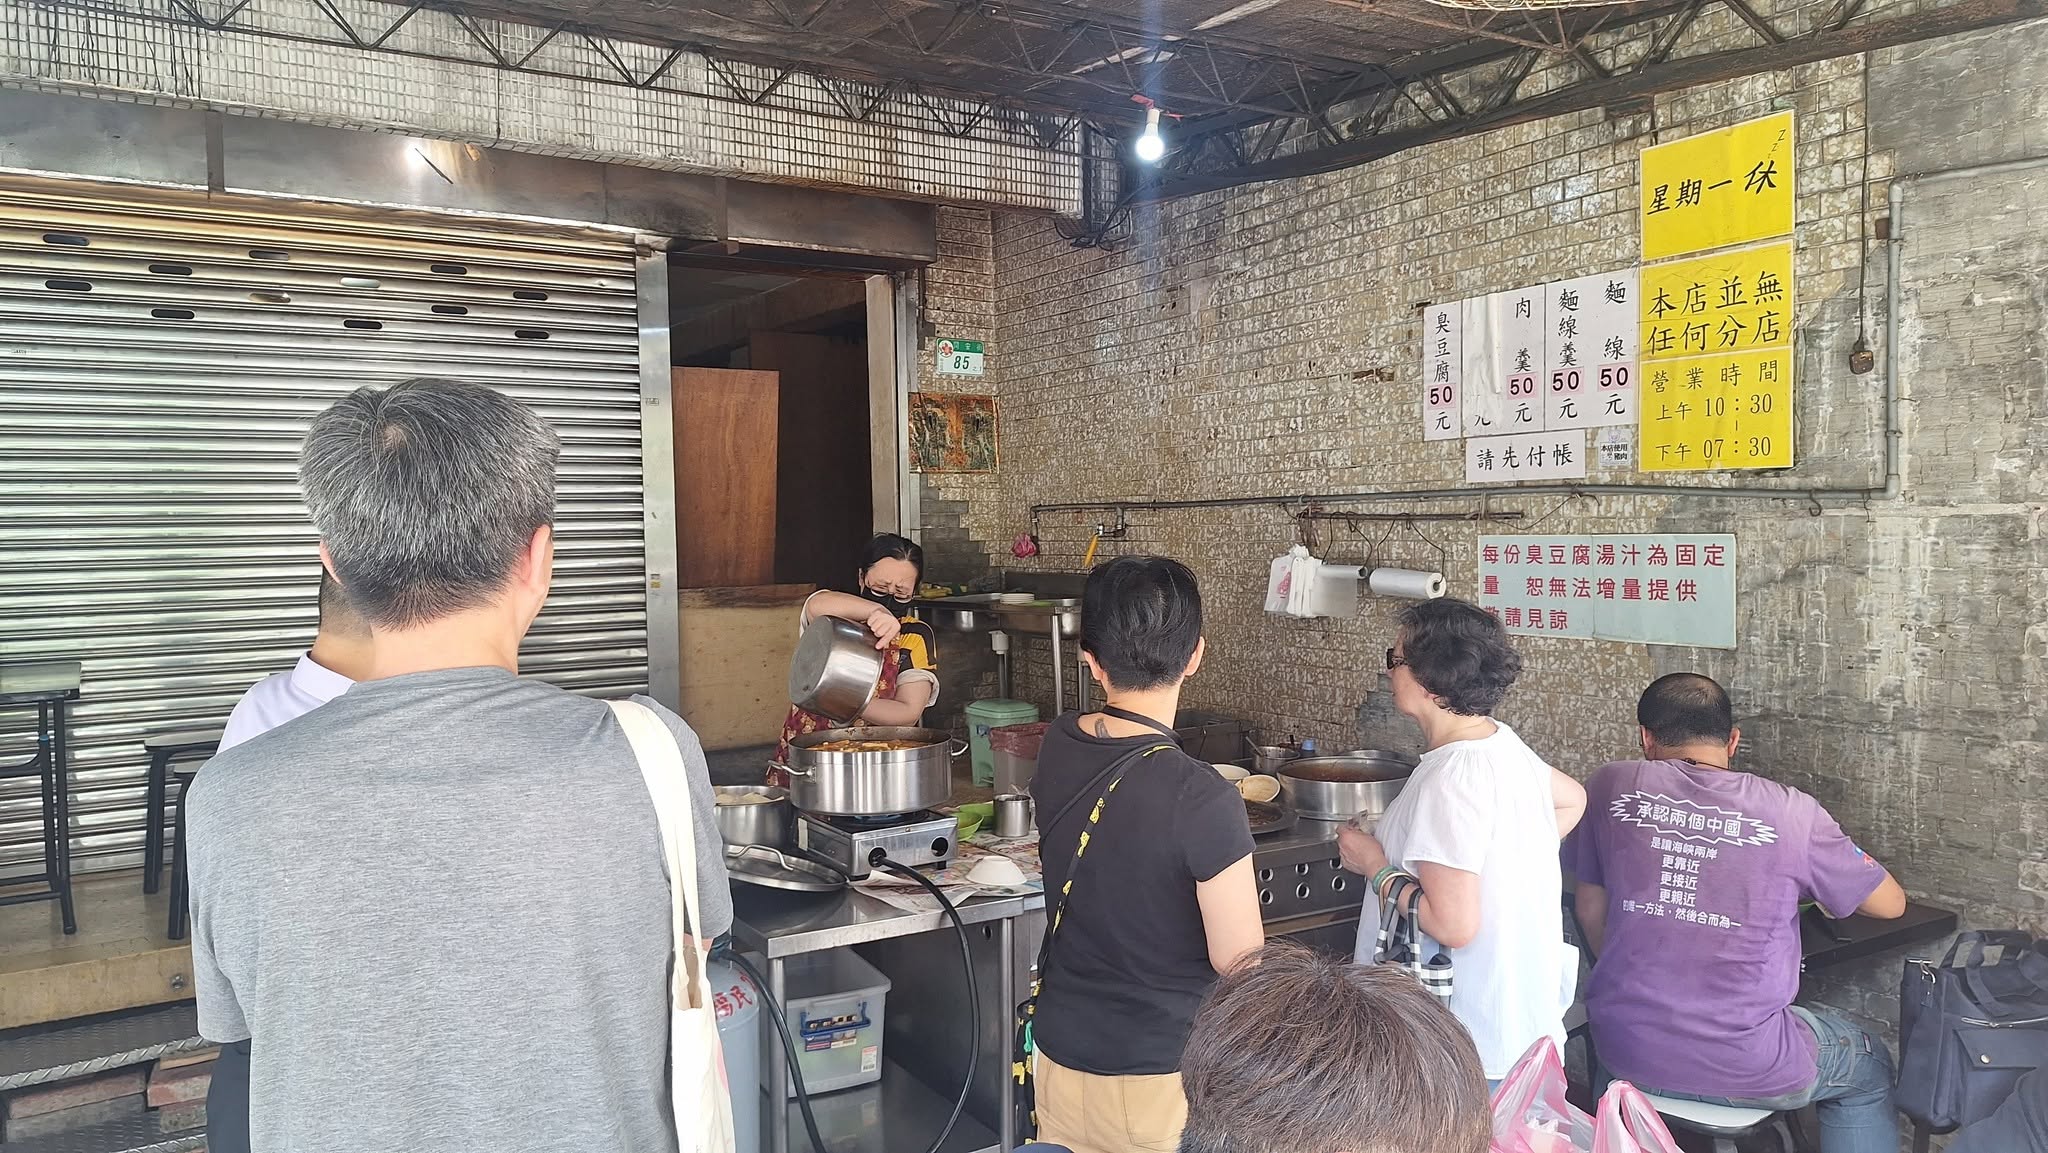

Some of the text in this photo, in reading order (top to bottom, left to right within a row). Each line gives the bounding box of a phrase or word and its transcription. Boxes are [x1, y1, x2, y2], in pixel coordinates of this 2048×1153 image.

[1647, 160, 1778, 215] 星期一休
[1648, 271, 1784, 319] 本店並無
[1647, 311, 1780, 355] 任何分店
[953, 355, 970, 370] 85
[1651, 360, 1778, 393] 營業時間
[1656, 402, 1692, 420] 上午
[1476, 443, 1574, 471] 請先付帳
[1655, 442, 1692, 462] 下午
[1482, 543, 1726, 567] 每份臭豆腐湯汁為固定
[1483, 575, 1698, 602] 量 恕無法增量提供
[1636, 800, 1741, 837] 承認兩個中國
[1650, 836, 1718, 860] 是讓海峽兩岸
[1661, 854, 1700, 874] 更靠近
[1659, 871, 1698, 890] 更接近
[1658, 887, 1696, 908] 更親近
